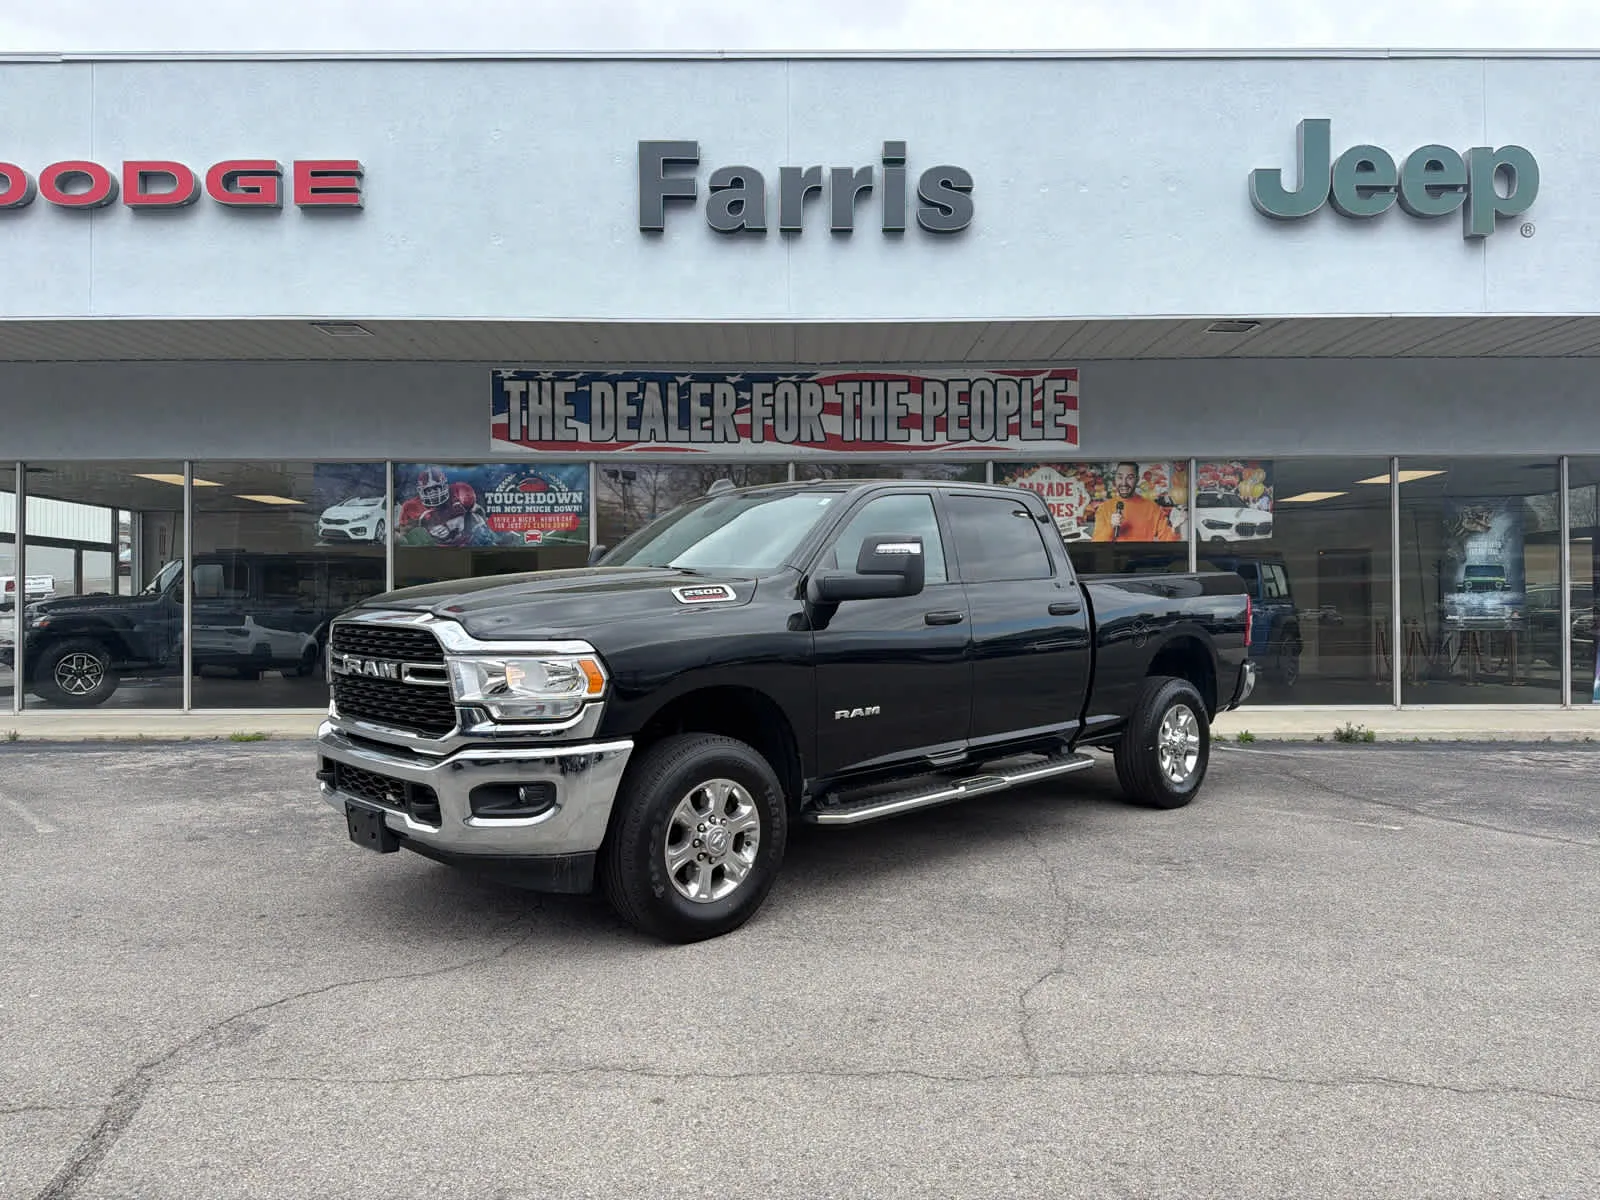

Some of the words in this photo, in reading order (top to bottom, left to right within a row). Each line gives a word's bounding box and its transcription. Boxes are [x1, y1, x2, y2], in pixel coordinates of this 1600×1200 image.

[638, 140, 975, 232] Farris
[1249, 119, 1540, 239] Jeep
[502, 379, 579, 442] THE
[589, 380, 740, 443] DEALER
[750, 380, 826, 443] FOR
[835, 379, 911, 442] THE
[921, 377, 1068, 442] PEOPLE
[485, 492, 583, 504] TOUCHDOWN
[486, 505, 501, 513] FOR
[504, 505, 523, 513] NOT
[525, 505, 551, 513] MUCH
[1047, 503, 1074, 518] DES
[684, 588, 723, 596] 2500
[343, 657, 398, 679] RAM
[835, 706, 880, 720] RAM
